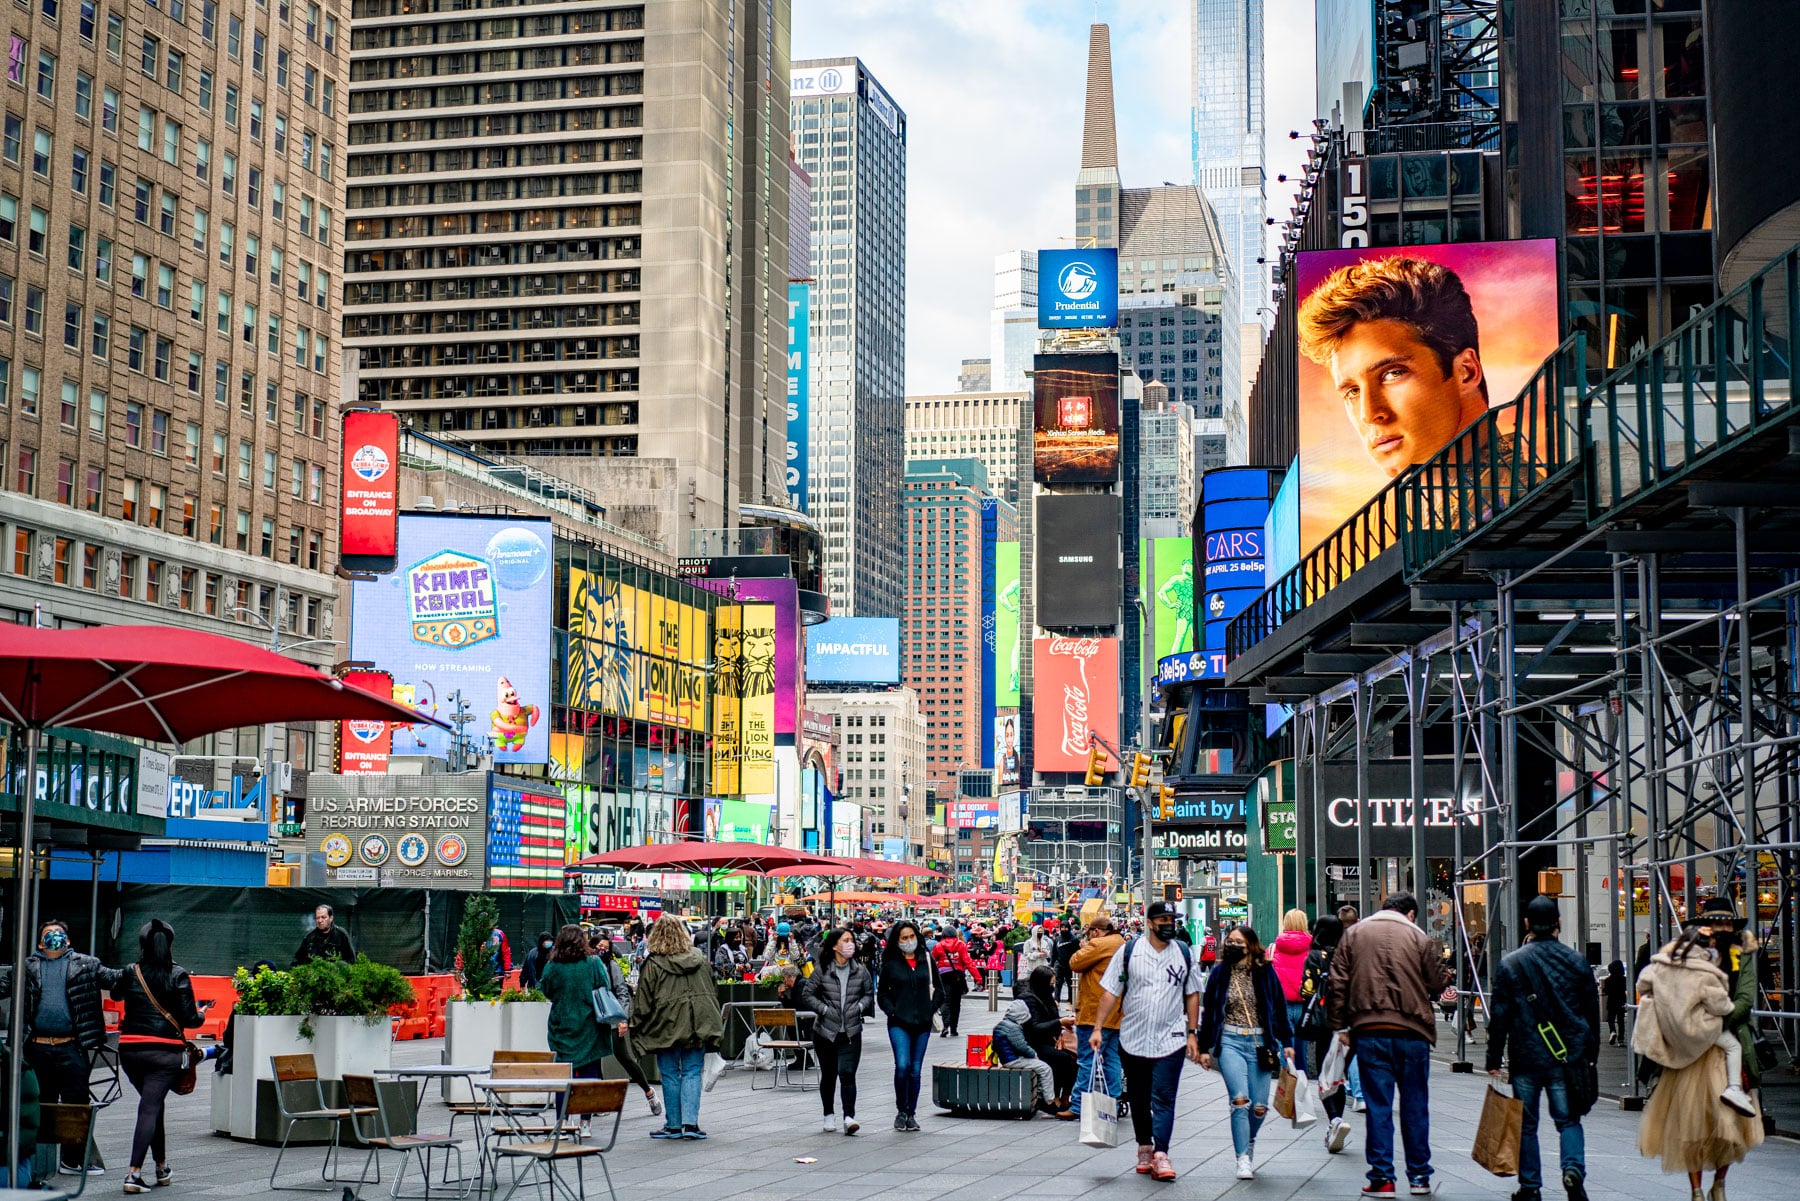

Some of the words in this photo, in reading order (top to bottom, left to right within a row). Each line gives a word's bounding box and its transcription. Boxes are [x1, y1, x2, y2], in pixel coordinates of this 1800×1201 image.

[793, 77, 814, 90] nz
[1342, 165, 1368, 248] 150
[1055, 301, 1100, 311] Prudential
[787, 301, 801, 421] TIMES
[1047, 429, 1066, 437] Xinhua
[347, 490, 393, 499] ENTRANCE
[345, 508, 393, 516] BROADWAY
[982, 510, 997, 602] NOVOTEL
[420, 560, 478, 572] nickelodeon
[1212, 564, 1228, 575] APRIL
[1230, 562, 1239, 572] 25
[413, 568, 488, 593] KAMP
[414, 590, 494, 613] KORAL
[1210, 599, 1225, 611] abc
[659, 620, 678, 648] THE
[816, 642, 889, 656] IMPACTFUL
[1049, 637, 1101, 658] Coca-Cola
[415, 663, 436, 671] NOW
[439, 664, 492, 672] STREAMING
[1189, 659, 1207, 670] abc
[639, 646, 669, 702] LION
[671, 655, 700, 708] KING
[749, 721, 766, 729] THE
[1062, 684, 1090, 756] Coca-Cola
[746, 731, 769, 744] LION
[345, 752, 387, 760] ENTRANCE
[744, 746, 772, 762] KING
[360, 761, 372, 769] ON
[167, 781, 203, 817] EPT
[312, 797, 339, 813] U.S.
[344, 796, 407, 812] ARMED
[410, 797, 478, 813] FORCES
[1152, 800, 1206, 822] coplaint
[1212, 799, 1234, 820] by
[279, 824, 284, 832] W
[286, 824, 294, 832] 43
[409, 815, 470, 828] STATION
[1170, 831, 1220, 848] Donald
[1162, 848, 1171, 856] 43
[383, 868, 394, 877] AIR
[398, 869, 427, 877] FORCE
[1325, 865, 1372, 876] CTIZE
[1175, 888, 1182, 899] 6
[1166, 965, 1185, 986] NY
